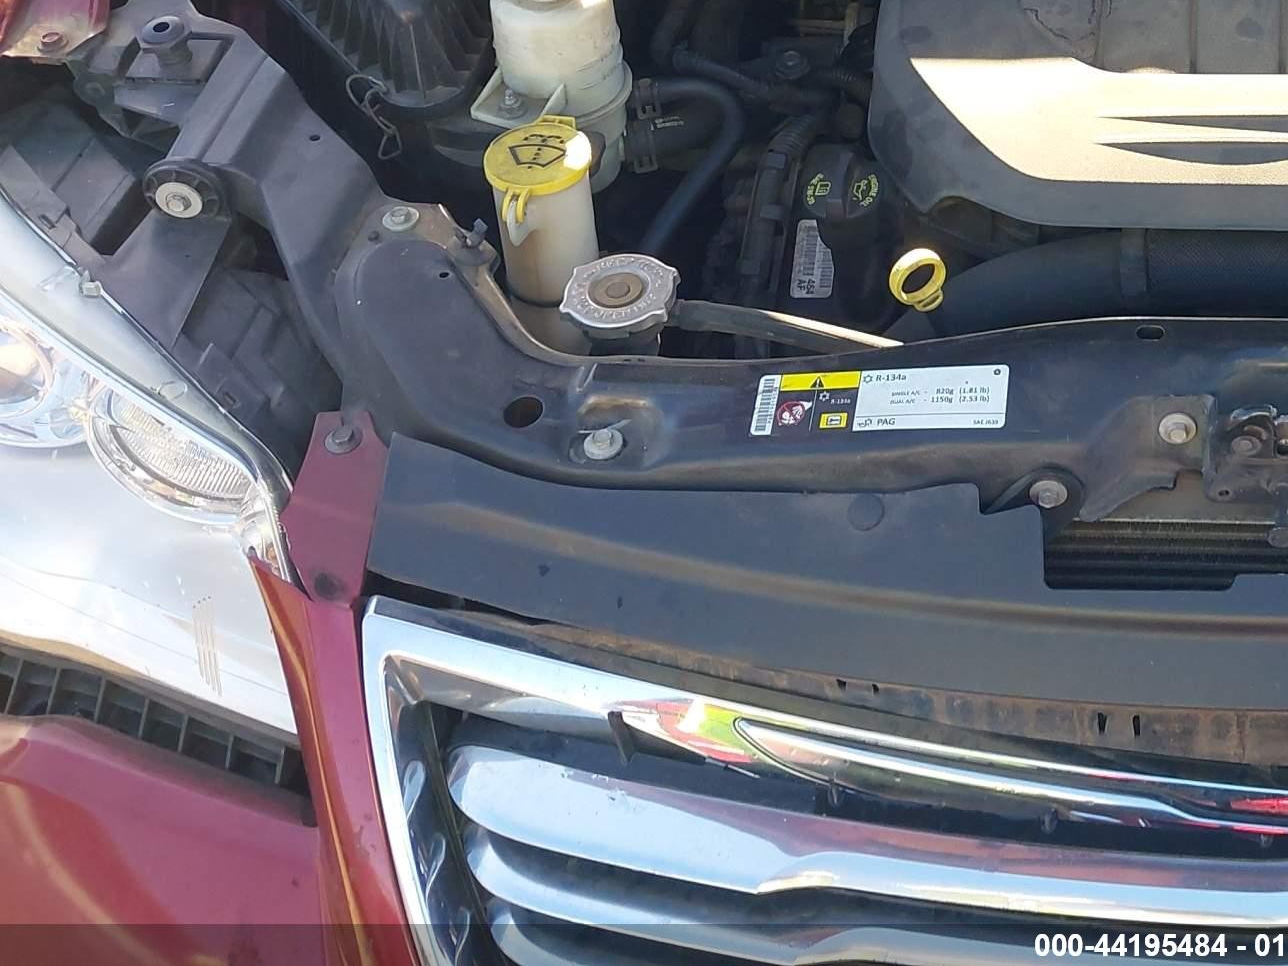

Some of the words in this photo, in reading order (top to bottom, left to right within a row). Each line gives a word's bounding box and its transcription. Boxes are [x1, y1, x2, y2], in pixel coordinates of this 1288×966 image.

[875, 373, 907, 382] R-134a
[935, 387, 954, 395] 820g
[959, 386, 977, 395] (1.81
[978, 386, 990, 394] lb)
[931, 395, 953, 405] 1150g
[959, 395, 977, 404] (2.53
[978, 394, 990, 403] lb)
[876, 418, 896, 426] PAG
